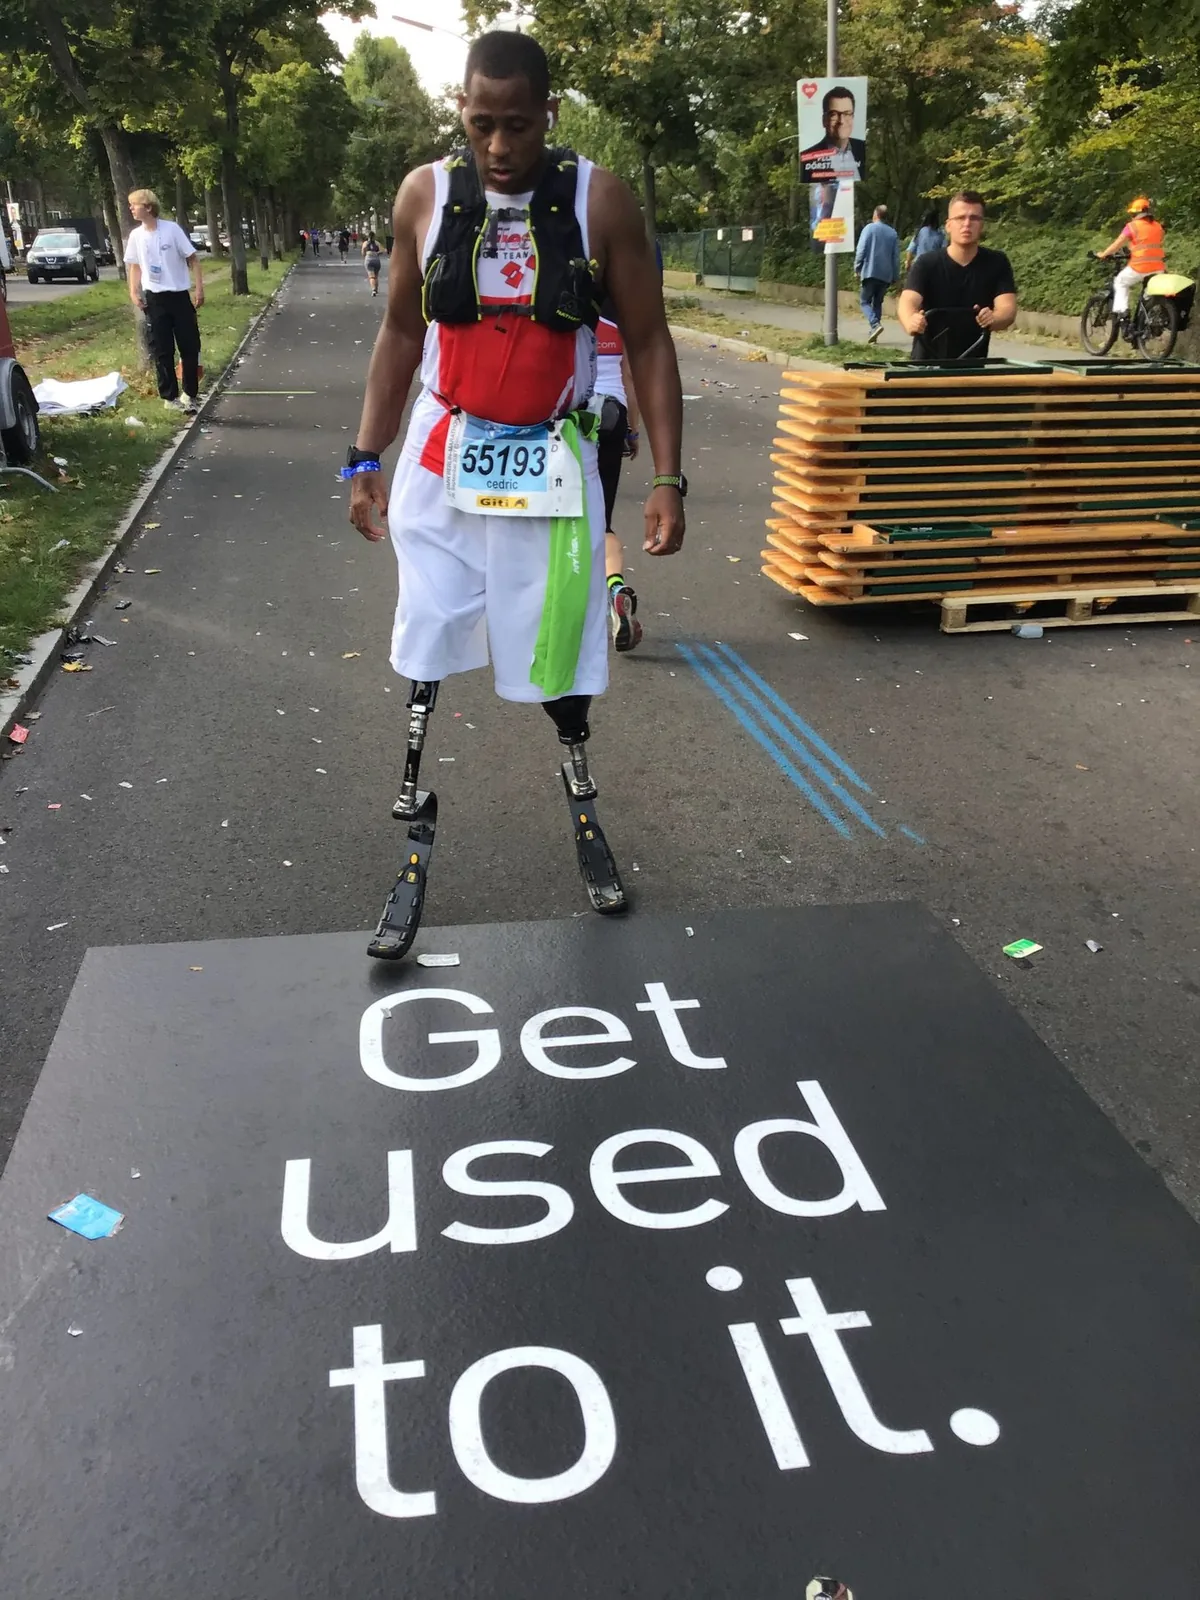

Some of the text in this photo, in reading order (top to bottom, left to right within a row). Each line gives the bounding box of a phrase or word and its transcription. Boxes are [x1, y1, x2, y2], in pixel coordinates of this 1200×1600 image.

[462, 444, 547, 478] 55193
[486, 478, 519, 490] cedric
[480, 498, 509, 507] Giti
[359, 982, 728, 1092] Get
[281, 1080, 887, 1261] used
[329, 1265, 1000, 1518] to it.
